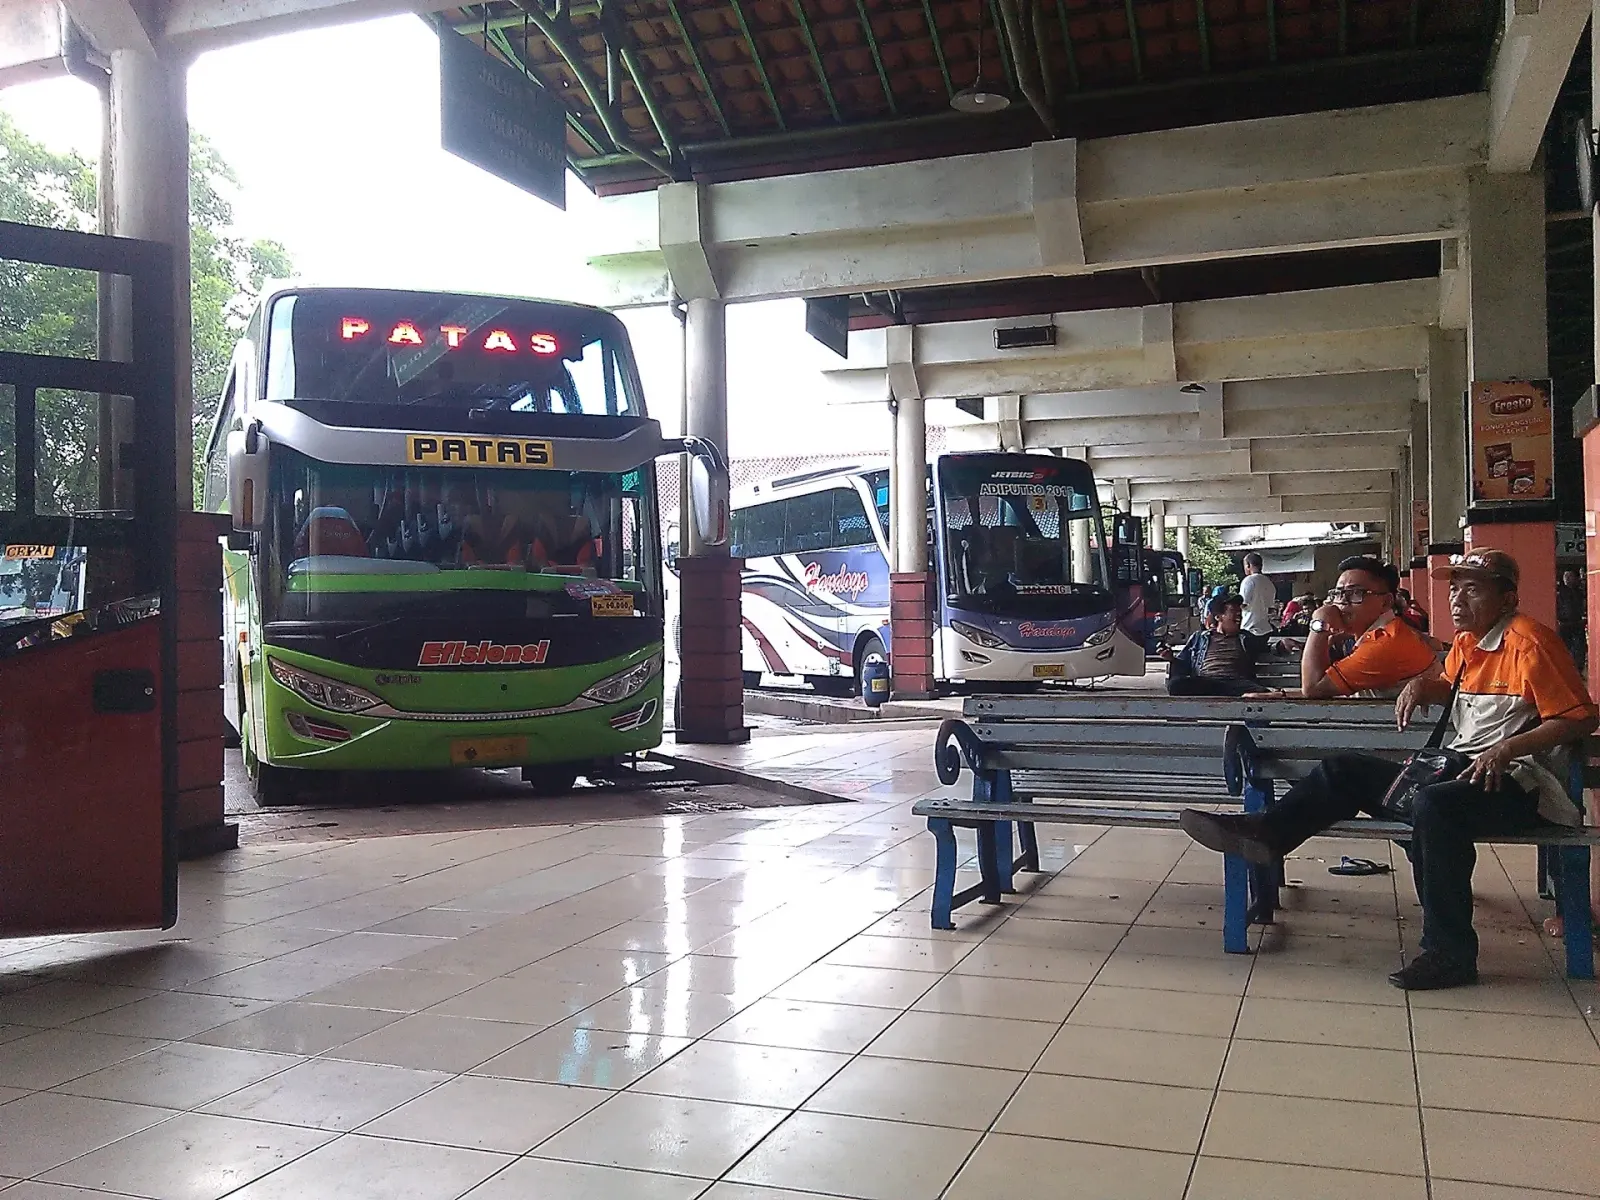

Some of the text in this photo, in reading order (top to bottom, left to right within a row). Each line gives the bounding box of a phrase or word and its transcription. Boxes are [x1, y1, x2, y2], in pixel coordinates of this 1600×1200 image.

[341, 316, 558, 354] PATAS
[413, 437, 549, 465] PATAS
[991, 471, 1034, 479] JETBUS
[980, 483, 1044, 496] ADIPUTRO
[7, 545, 51, 557] CEPAT
[804, 560, 869, 602] Handoyo
[1018, 621, 1076, 638] Handoyo
[418, 640, 550, 666] Efisiensi
